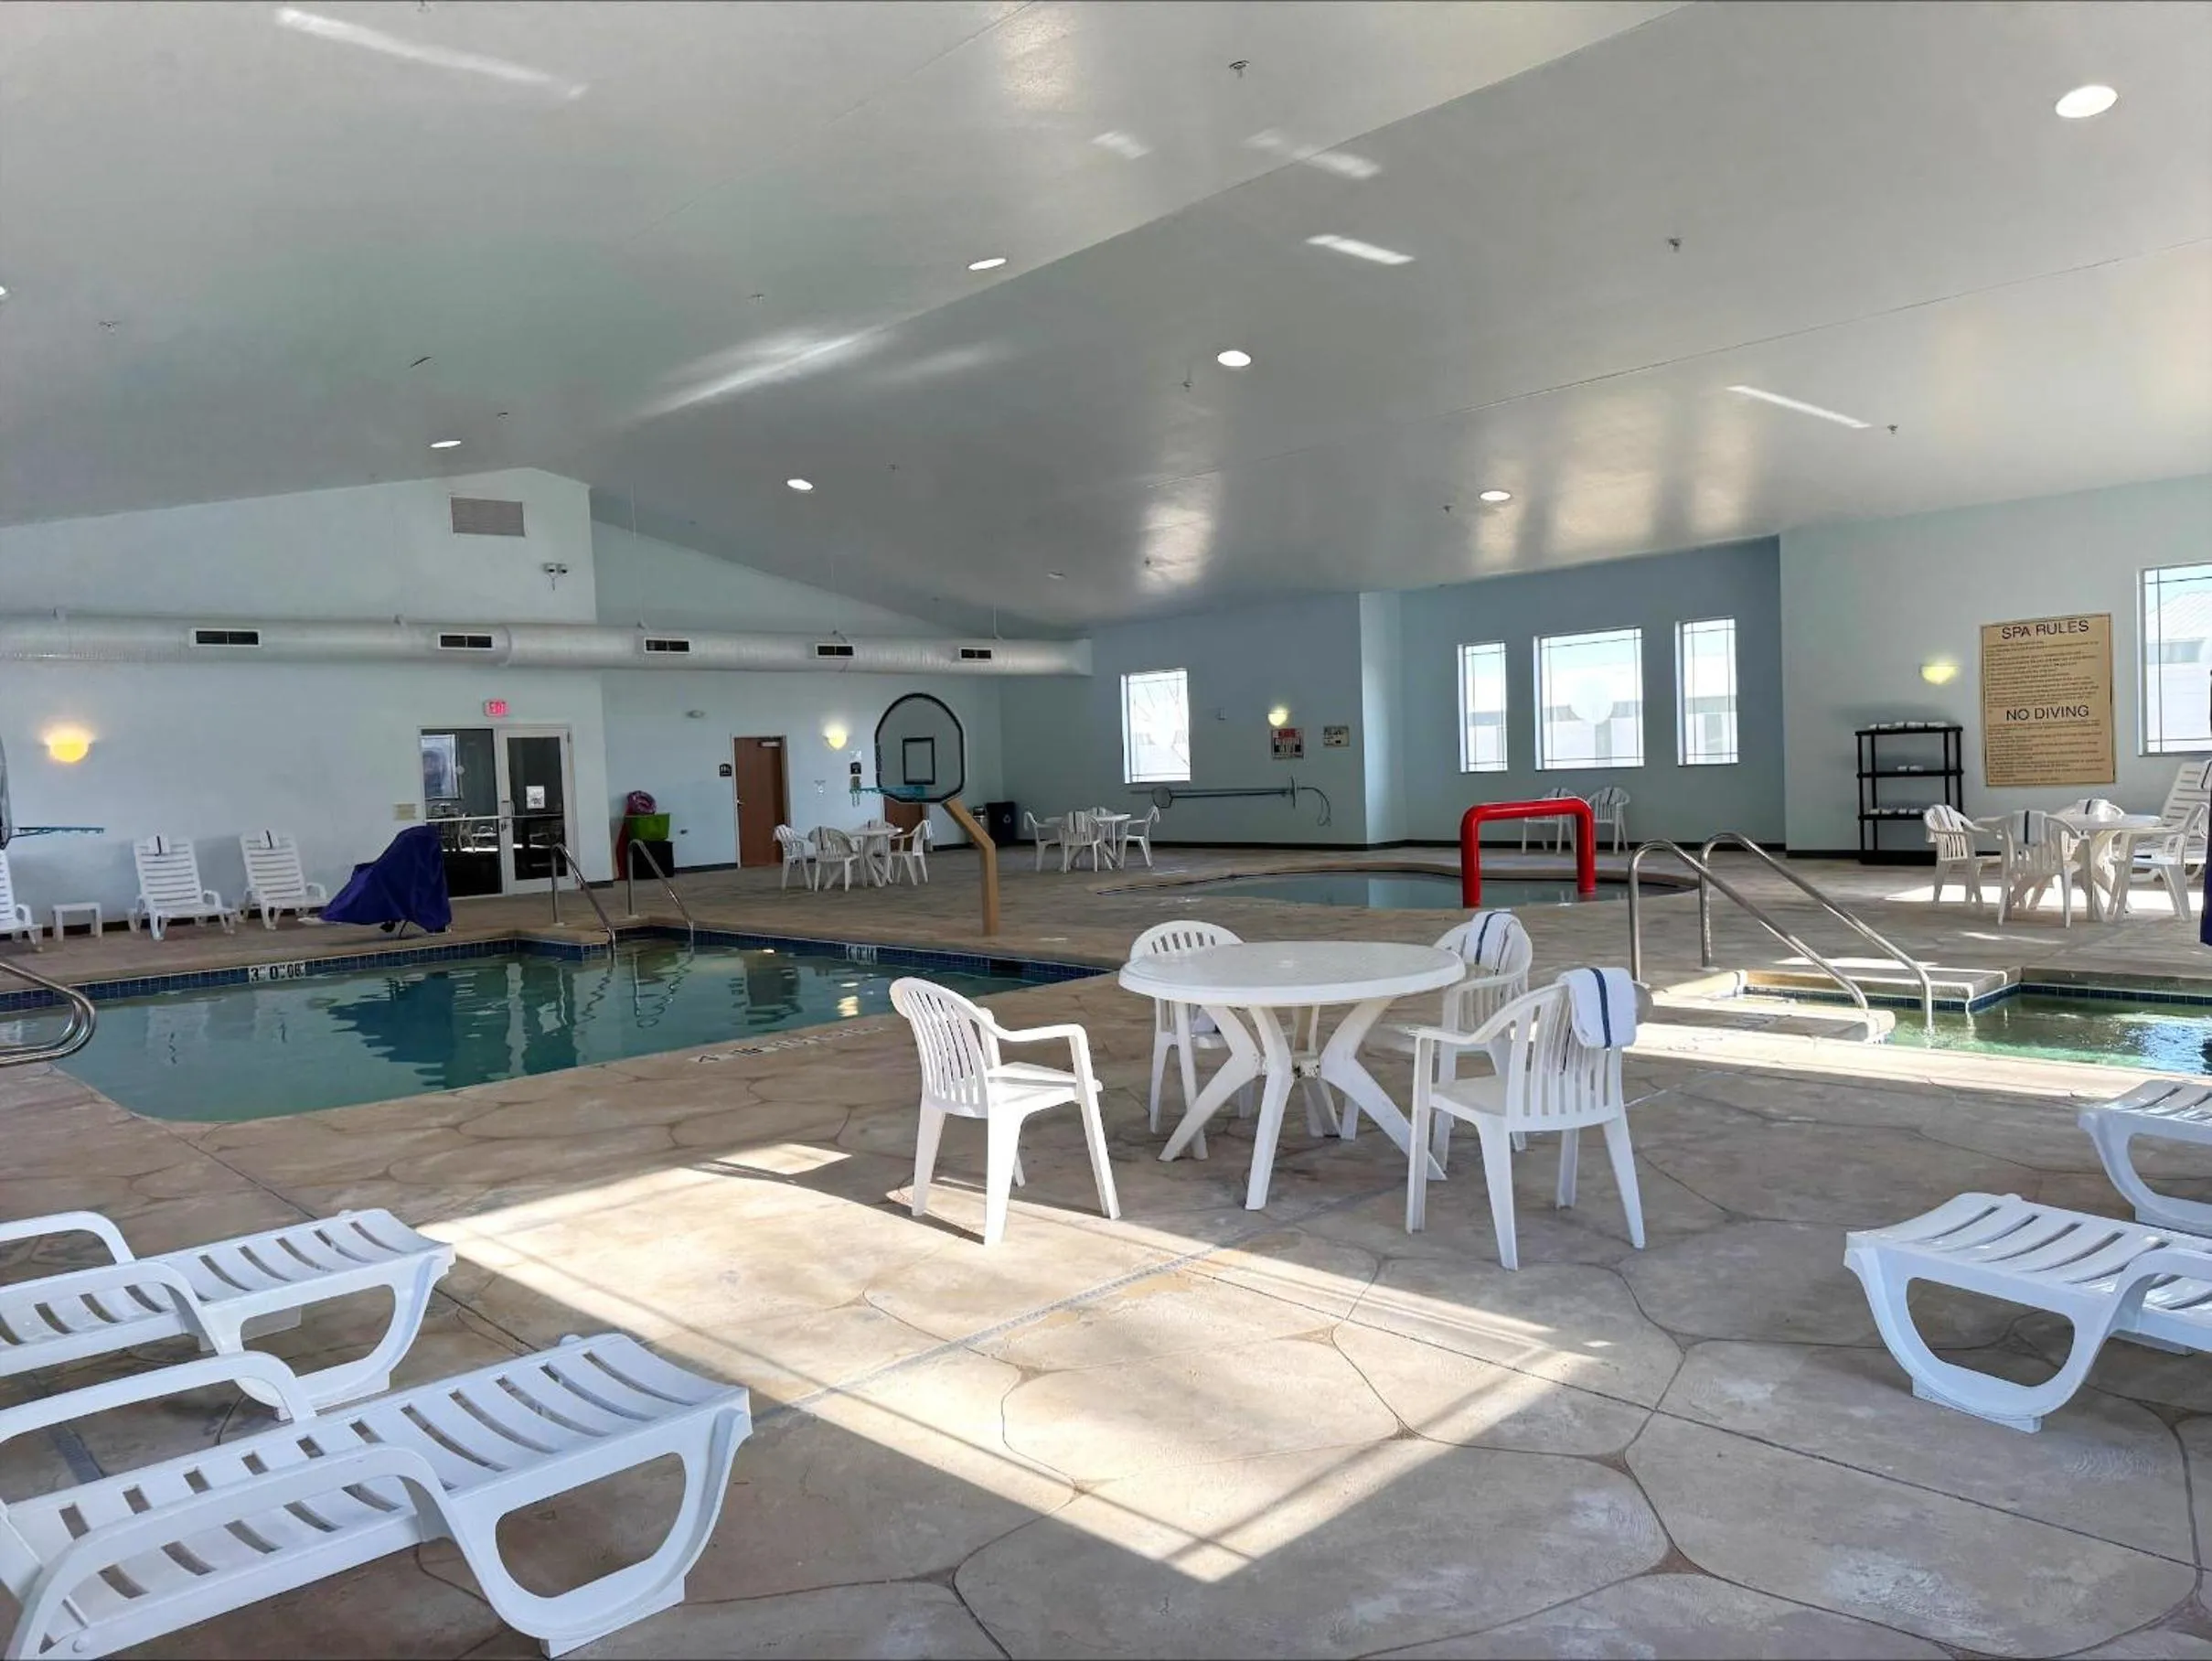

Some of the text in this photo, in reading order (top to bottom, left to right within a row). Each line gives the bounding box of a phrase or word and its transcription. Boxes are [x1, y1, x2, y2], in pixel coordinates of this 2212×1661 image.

[2001, 619, 2089, 640] SPA RULES
[2006, 704, 2089, 722] NO DIVING
